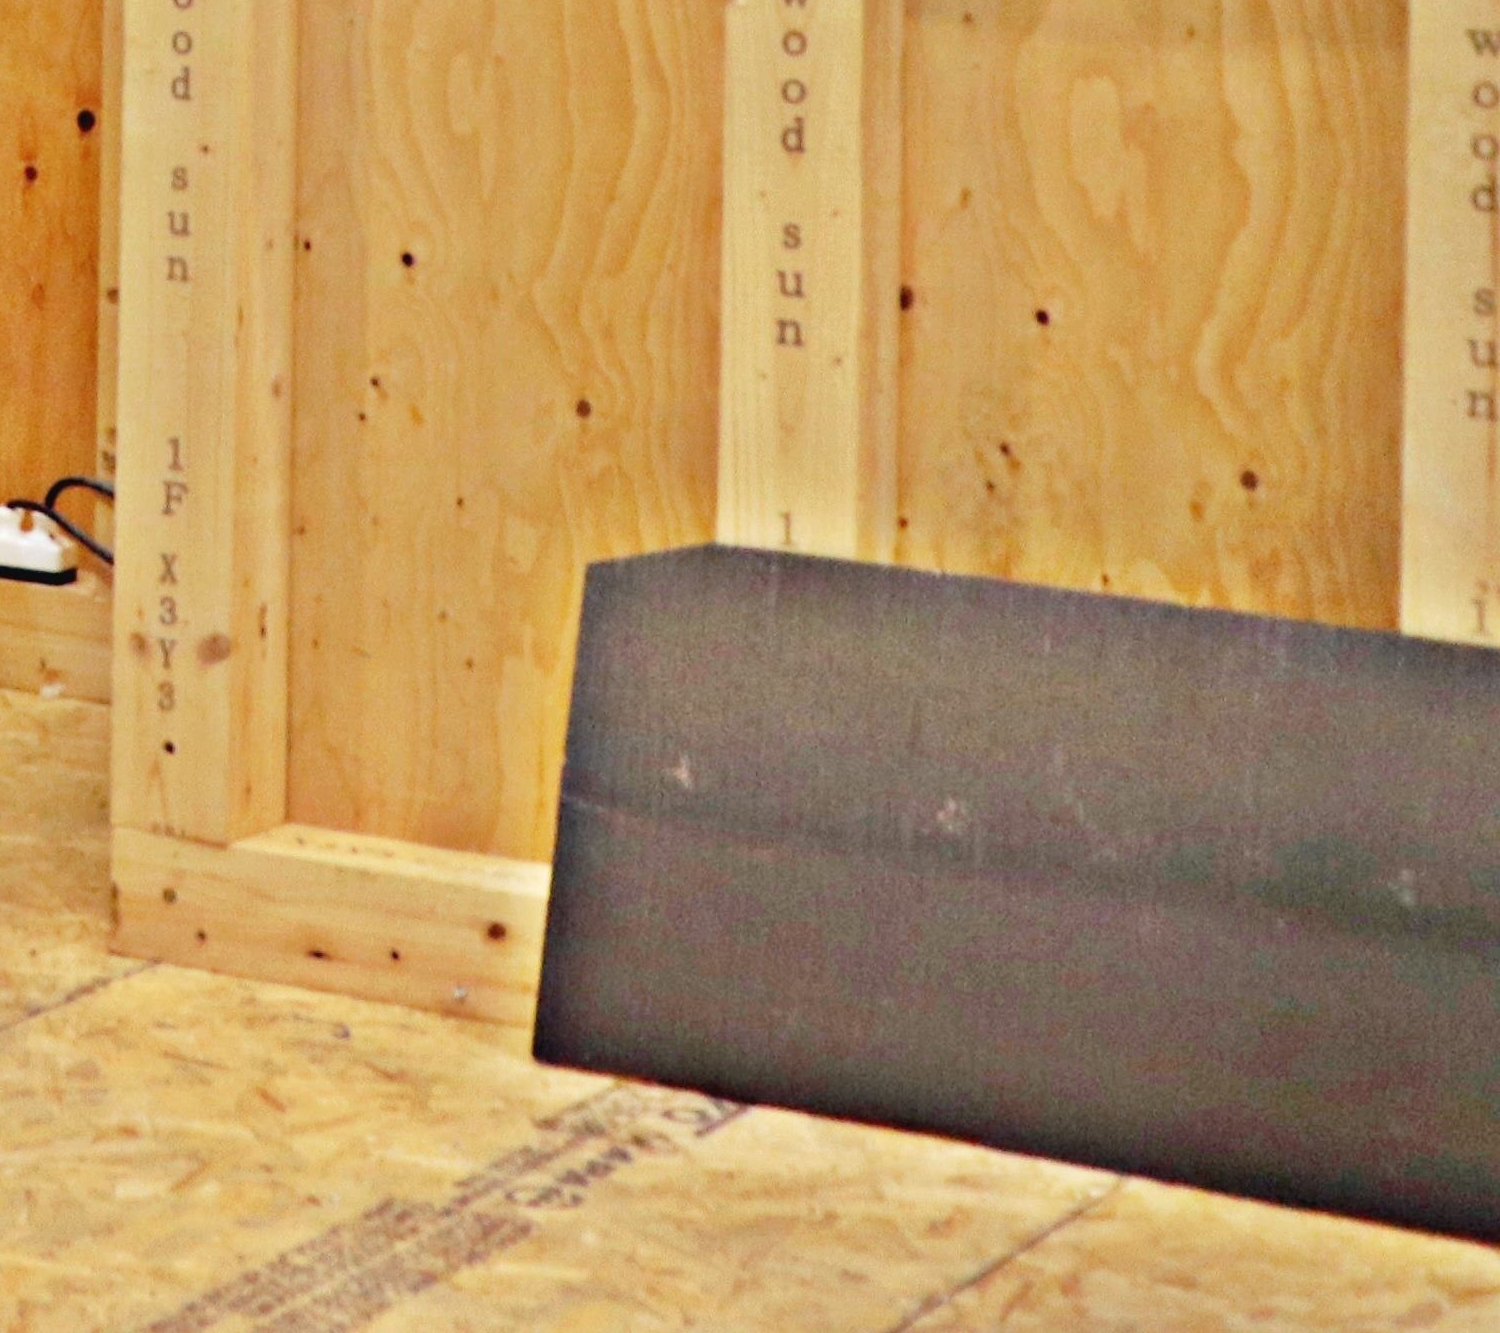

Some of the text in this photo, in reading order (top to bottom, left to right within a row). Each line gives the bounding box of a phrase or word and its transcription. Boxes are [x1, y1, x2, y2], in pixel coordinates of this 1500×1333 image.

[165, 166, 192, 283] sun
[775, 220, 806, 347] sun
[1466, 28, 1500, 422] wood sun
[161, 438, 188, 517] 1F
